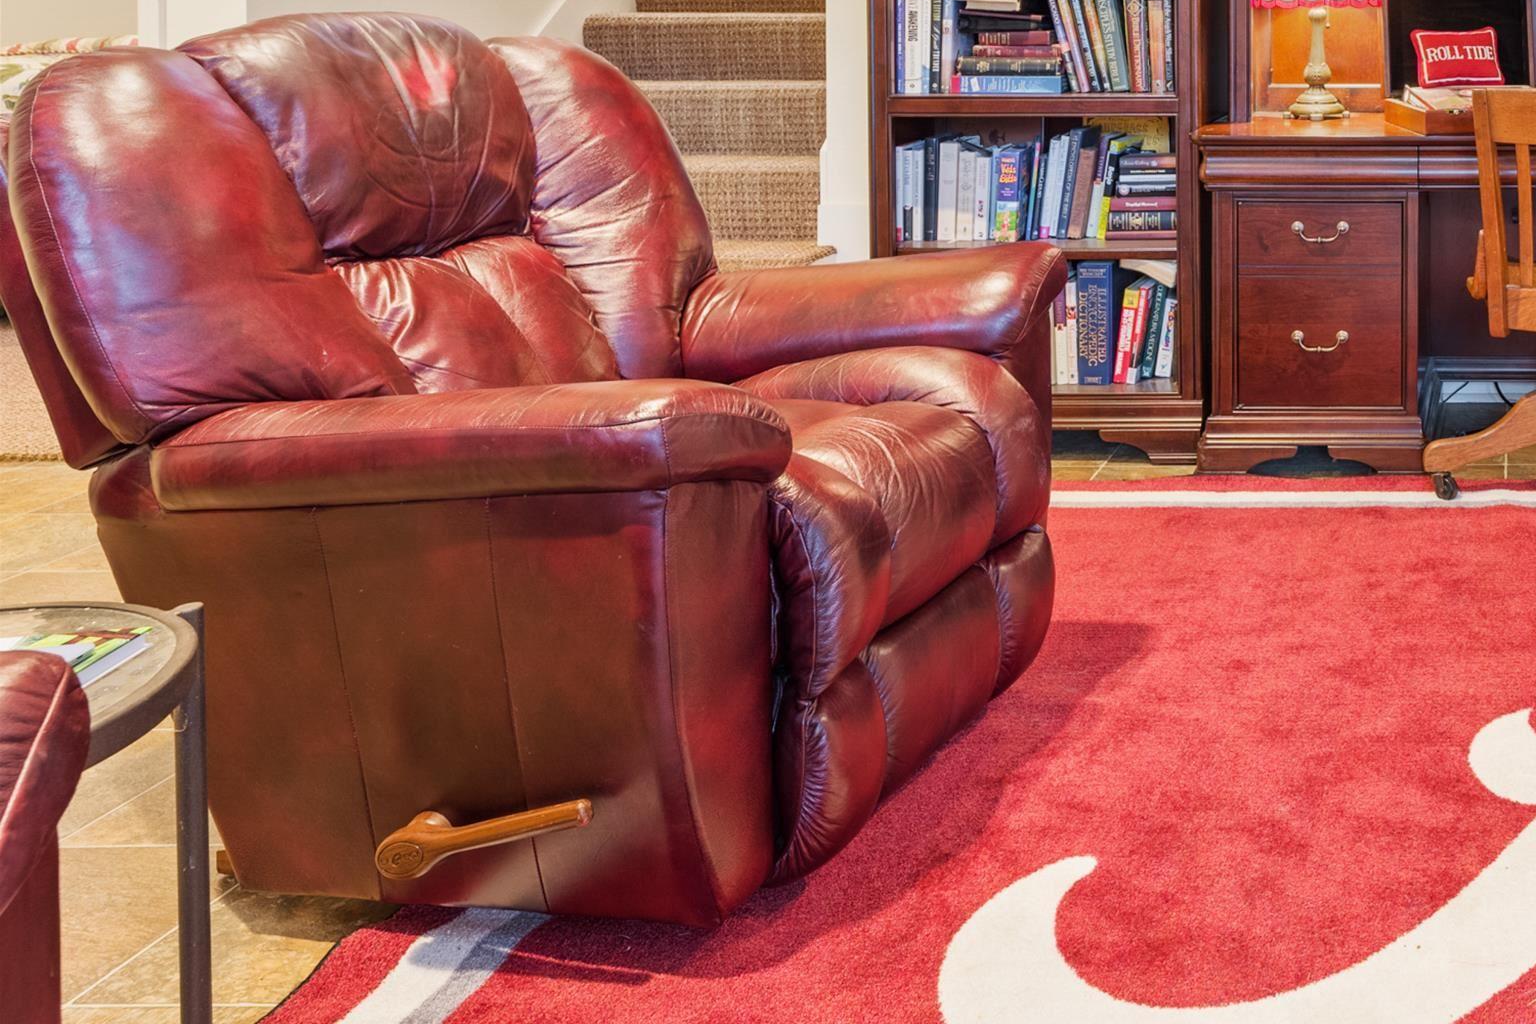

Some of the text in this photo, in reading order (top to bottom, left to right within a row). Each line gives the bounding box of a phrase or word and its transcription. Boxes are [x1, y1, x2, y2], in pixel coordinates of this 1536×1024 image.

[908, 11, 919, 41] AWAKENING
[1104, 33, 1116, 60] STUDY
[1131, 17, 1142, 89] BIBLE DICTIONARY
[1426, 45, 1494, 63] ROLL TIDE
[1109, 61, 1120, 82] BIBLE
[1066, 142, 1077, 182] ENCYCLOPEDIA
[1105, 166, 1115, 185] Banjo
[1079, 292, 1089, 360] DICTIONARY
[1088, 284, 1098, 367] ENCYCLOPEDIC
[1097, 288, 1107, 363] ILLUSTRATED
[1151, 307, 1161, 333] NATURAL
[1146, 334, 1157, 362] MEDICINE
